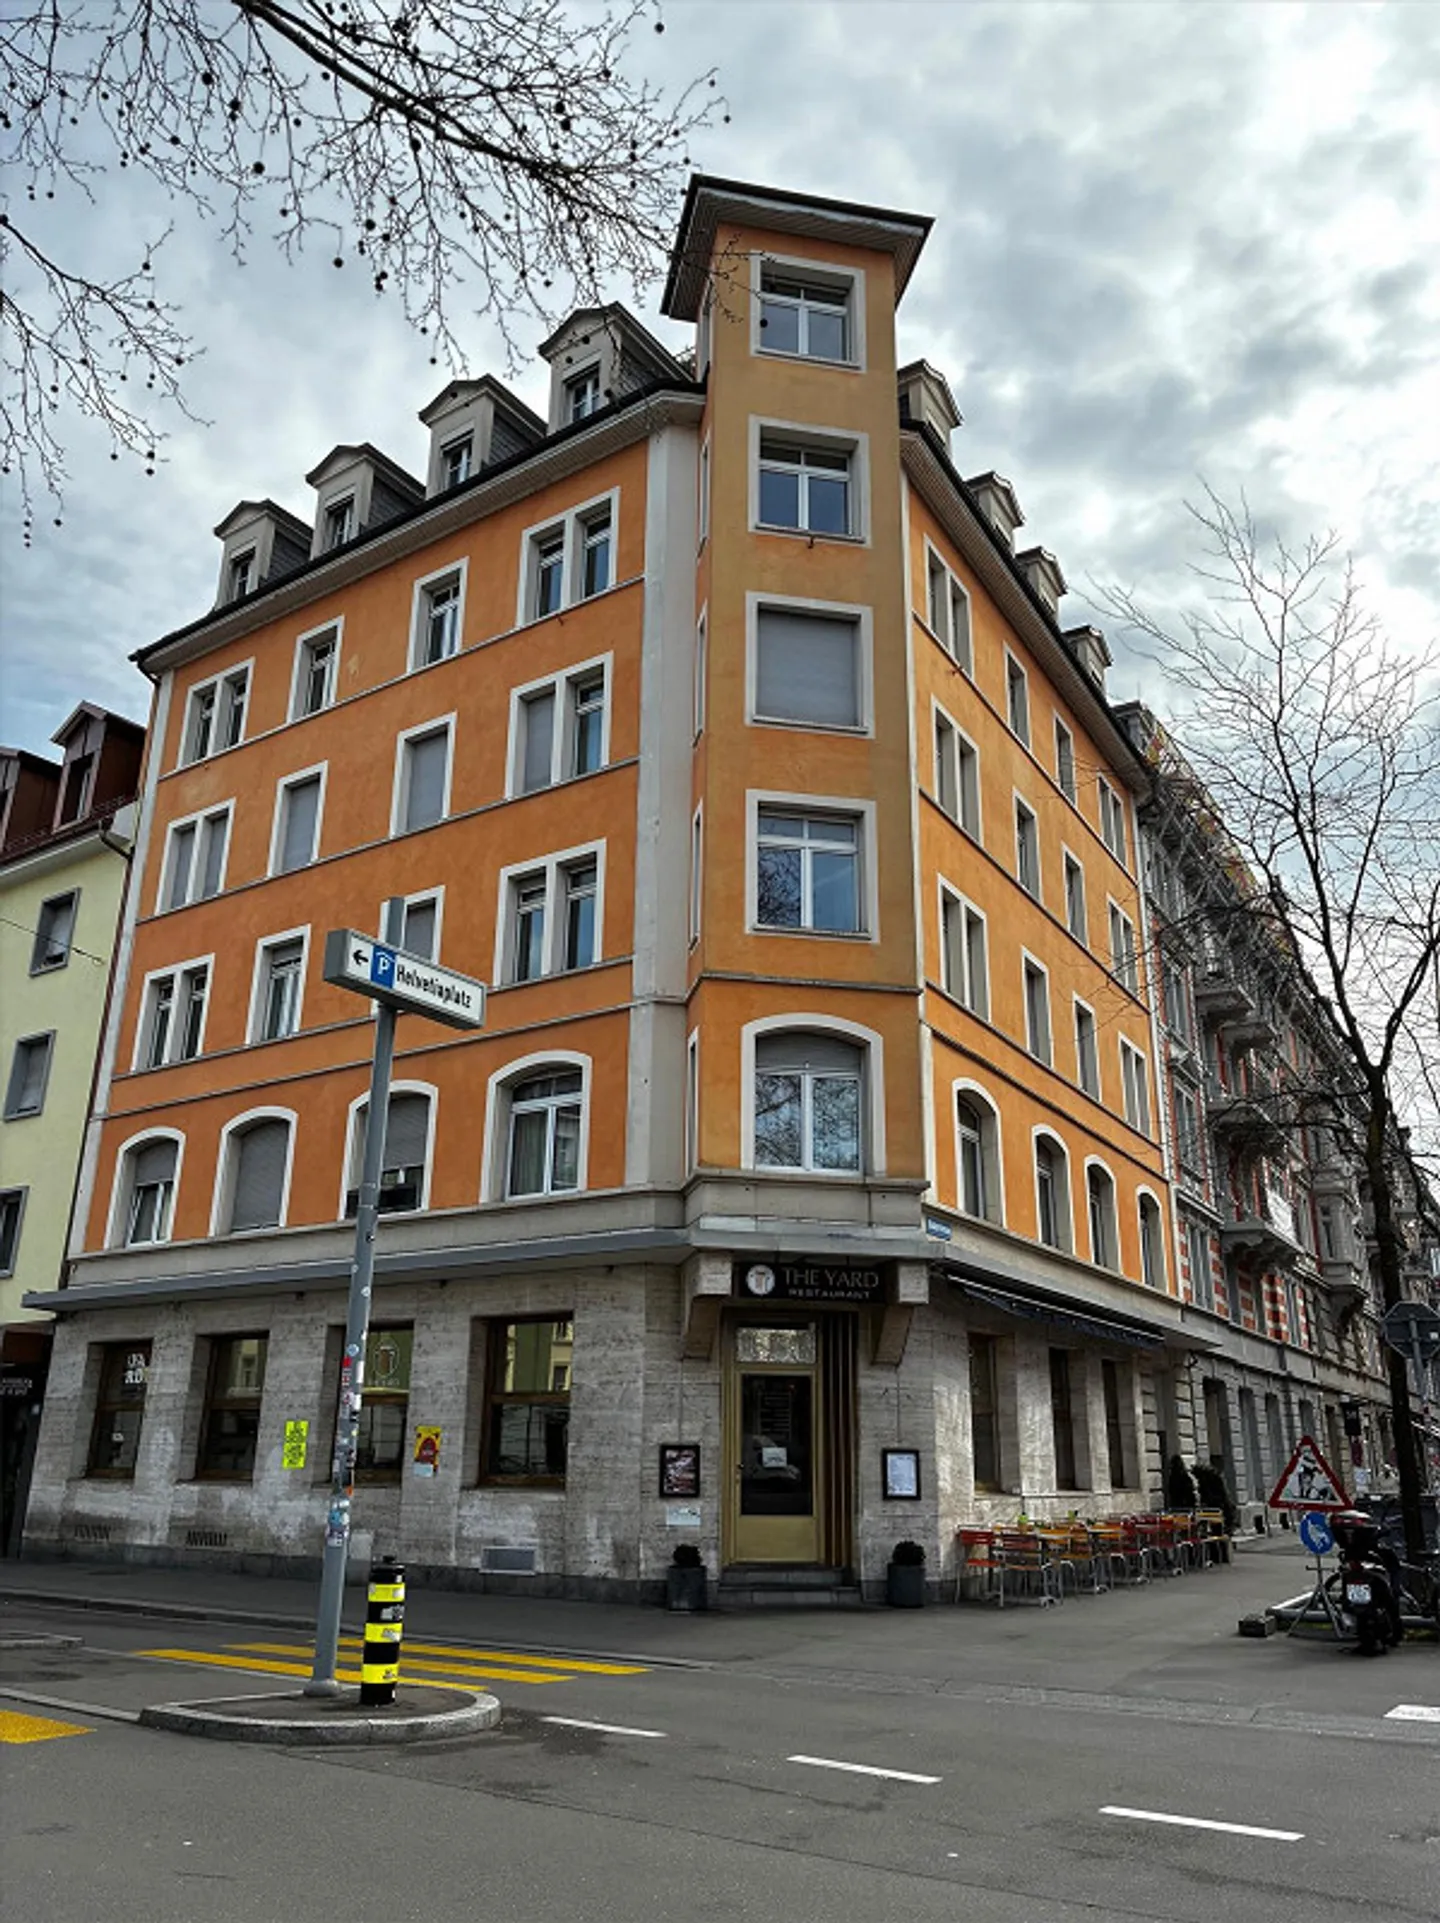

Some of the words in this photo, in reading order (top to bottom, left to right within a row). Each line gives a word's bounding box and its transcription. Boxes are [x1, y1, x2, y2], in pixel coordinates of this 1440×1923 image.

[378, 957, 390, 975] P
[397, 965, 472, 1008] Helvetiaplatz
[782, 1267, 820, 1286] THE
[824, 1269, 879, 1288] YARD
[788, 1289, 870, 1299] RESTAURANT
